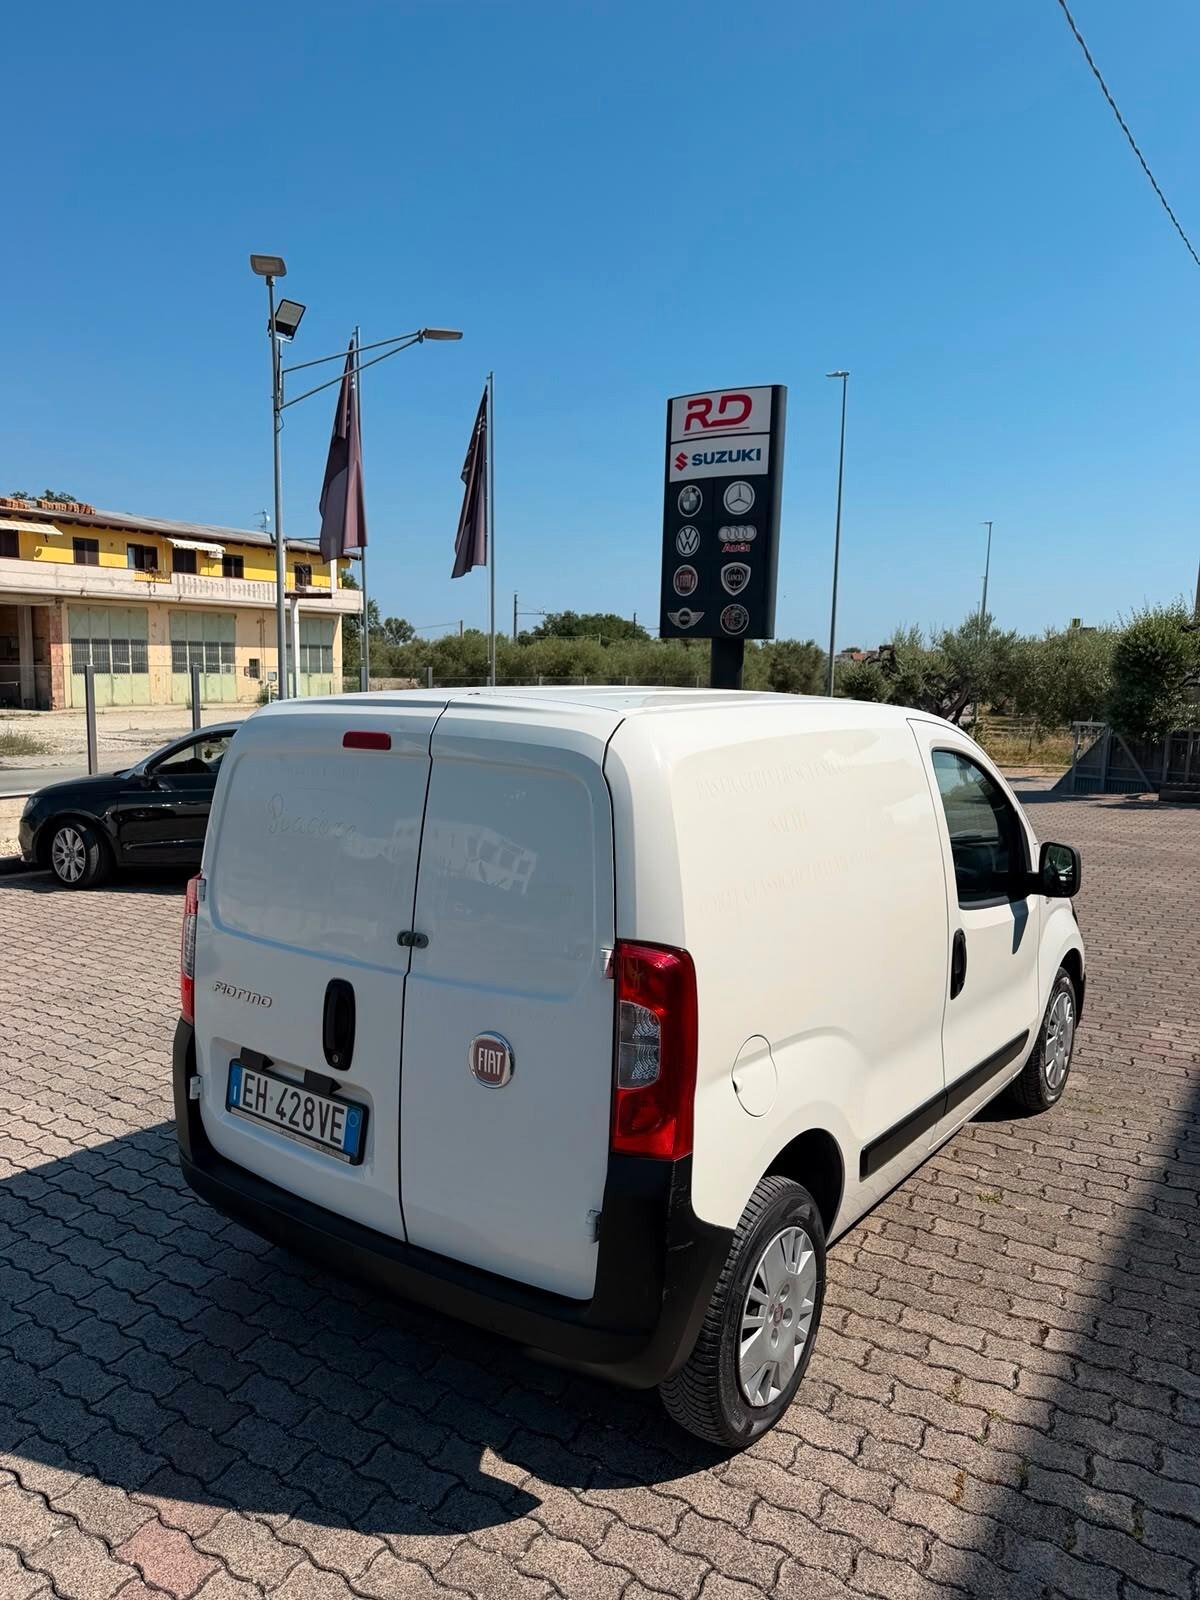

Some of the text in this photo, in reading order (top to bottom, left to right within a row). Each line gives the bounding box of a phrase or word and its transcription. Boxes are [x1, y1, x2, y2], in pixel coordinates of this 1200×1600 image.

[684, 394, 752, 431] RD
[692, 448, 761, 466] SUZUKI
[478, 1047, 503, 1075] FIAT
